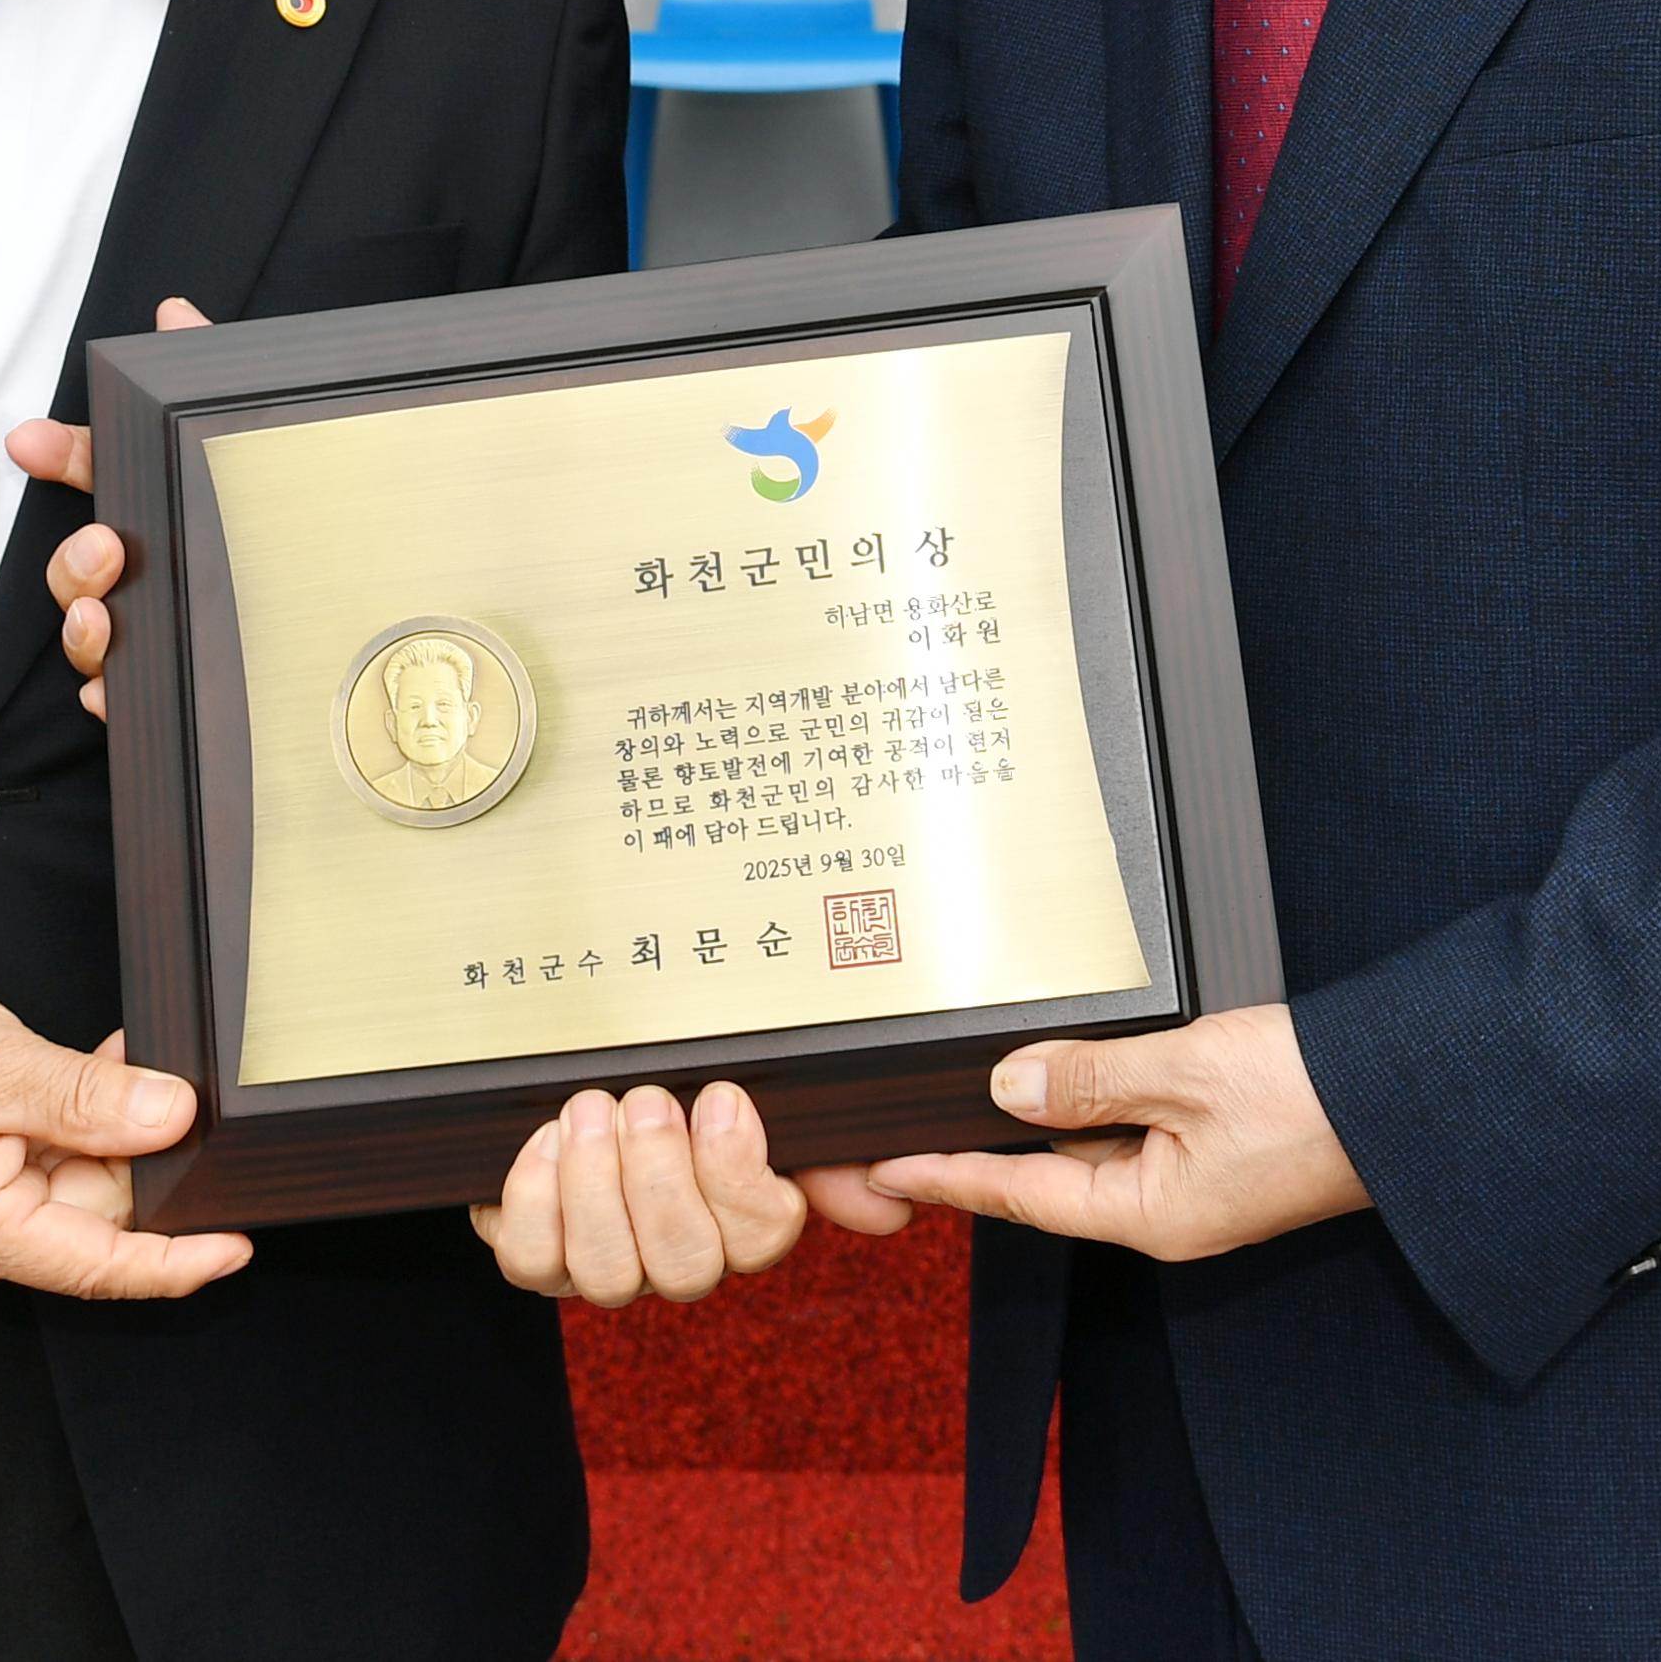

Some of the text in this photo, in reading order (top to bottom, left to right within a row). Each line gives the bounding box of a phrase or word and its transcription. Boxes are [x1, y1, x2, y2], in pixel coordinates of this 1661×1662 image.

[916, 527, 954, 567] 상
[824, 591, 996, 629] 하남면 용화산로
[627, 667, 1005, 730] 귀하께서는 지역개발 분야에서 남다른
[615, 733, 685, 762] 창의와
[696, 722, 789, 751] 노력으로
[799, 711, 869, 741] 군민의
[882, 703, 949, 731] 귀감이
[617, 727, 1010, 793] 물론 향토발전에 기여한 공적이 현저
[620, 757, 1015, 823] 하므로 화천군민의 감사한 마음을
[624, 806, 853, 853] 이 패에 담아 드립니다.
[744, 844, 906, 882] 2025년 9월 30일
